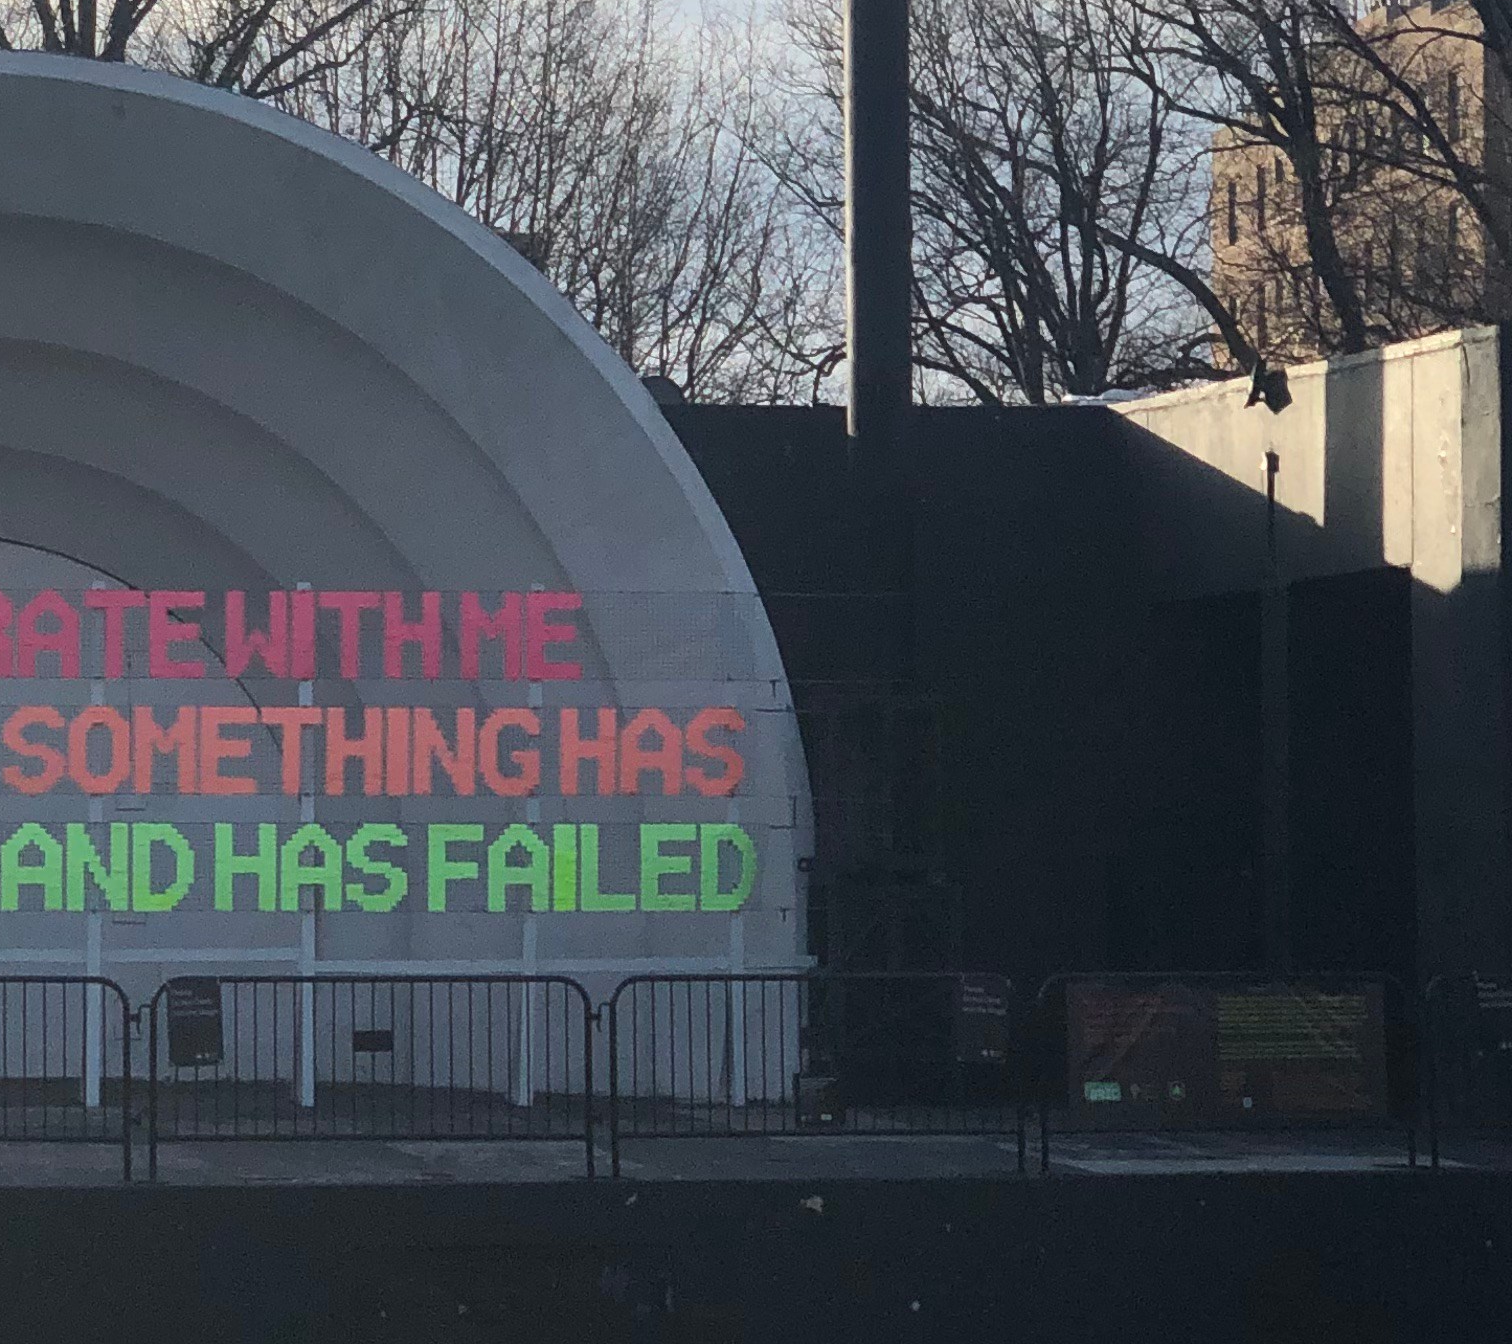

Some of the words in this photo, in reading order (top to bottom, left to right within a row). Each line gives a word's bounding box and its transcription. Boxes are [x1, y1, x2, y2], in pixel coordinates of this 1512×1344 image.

[224, 588, 443, 681] WITH
[459, 590, 583, 682] ME
[1, 704, 541, 797] SOMETHING
[558, 706, 746, 797] HAS
[0, 821, 196, 913] AND
[213, 822, 409, 913] HAS
[426, 822, 758, 913] FAILED
